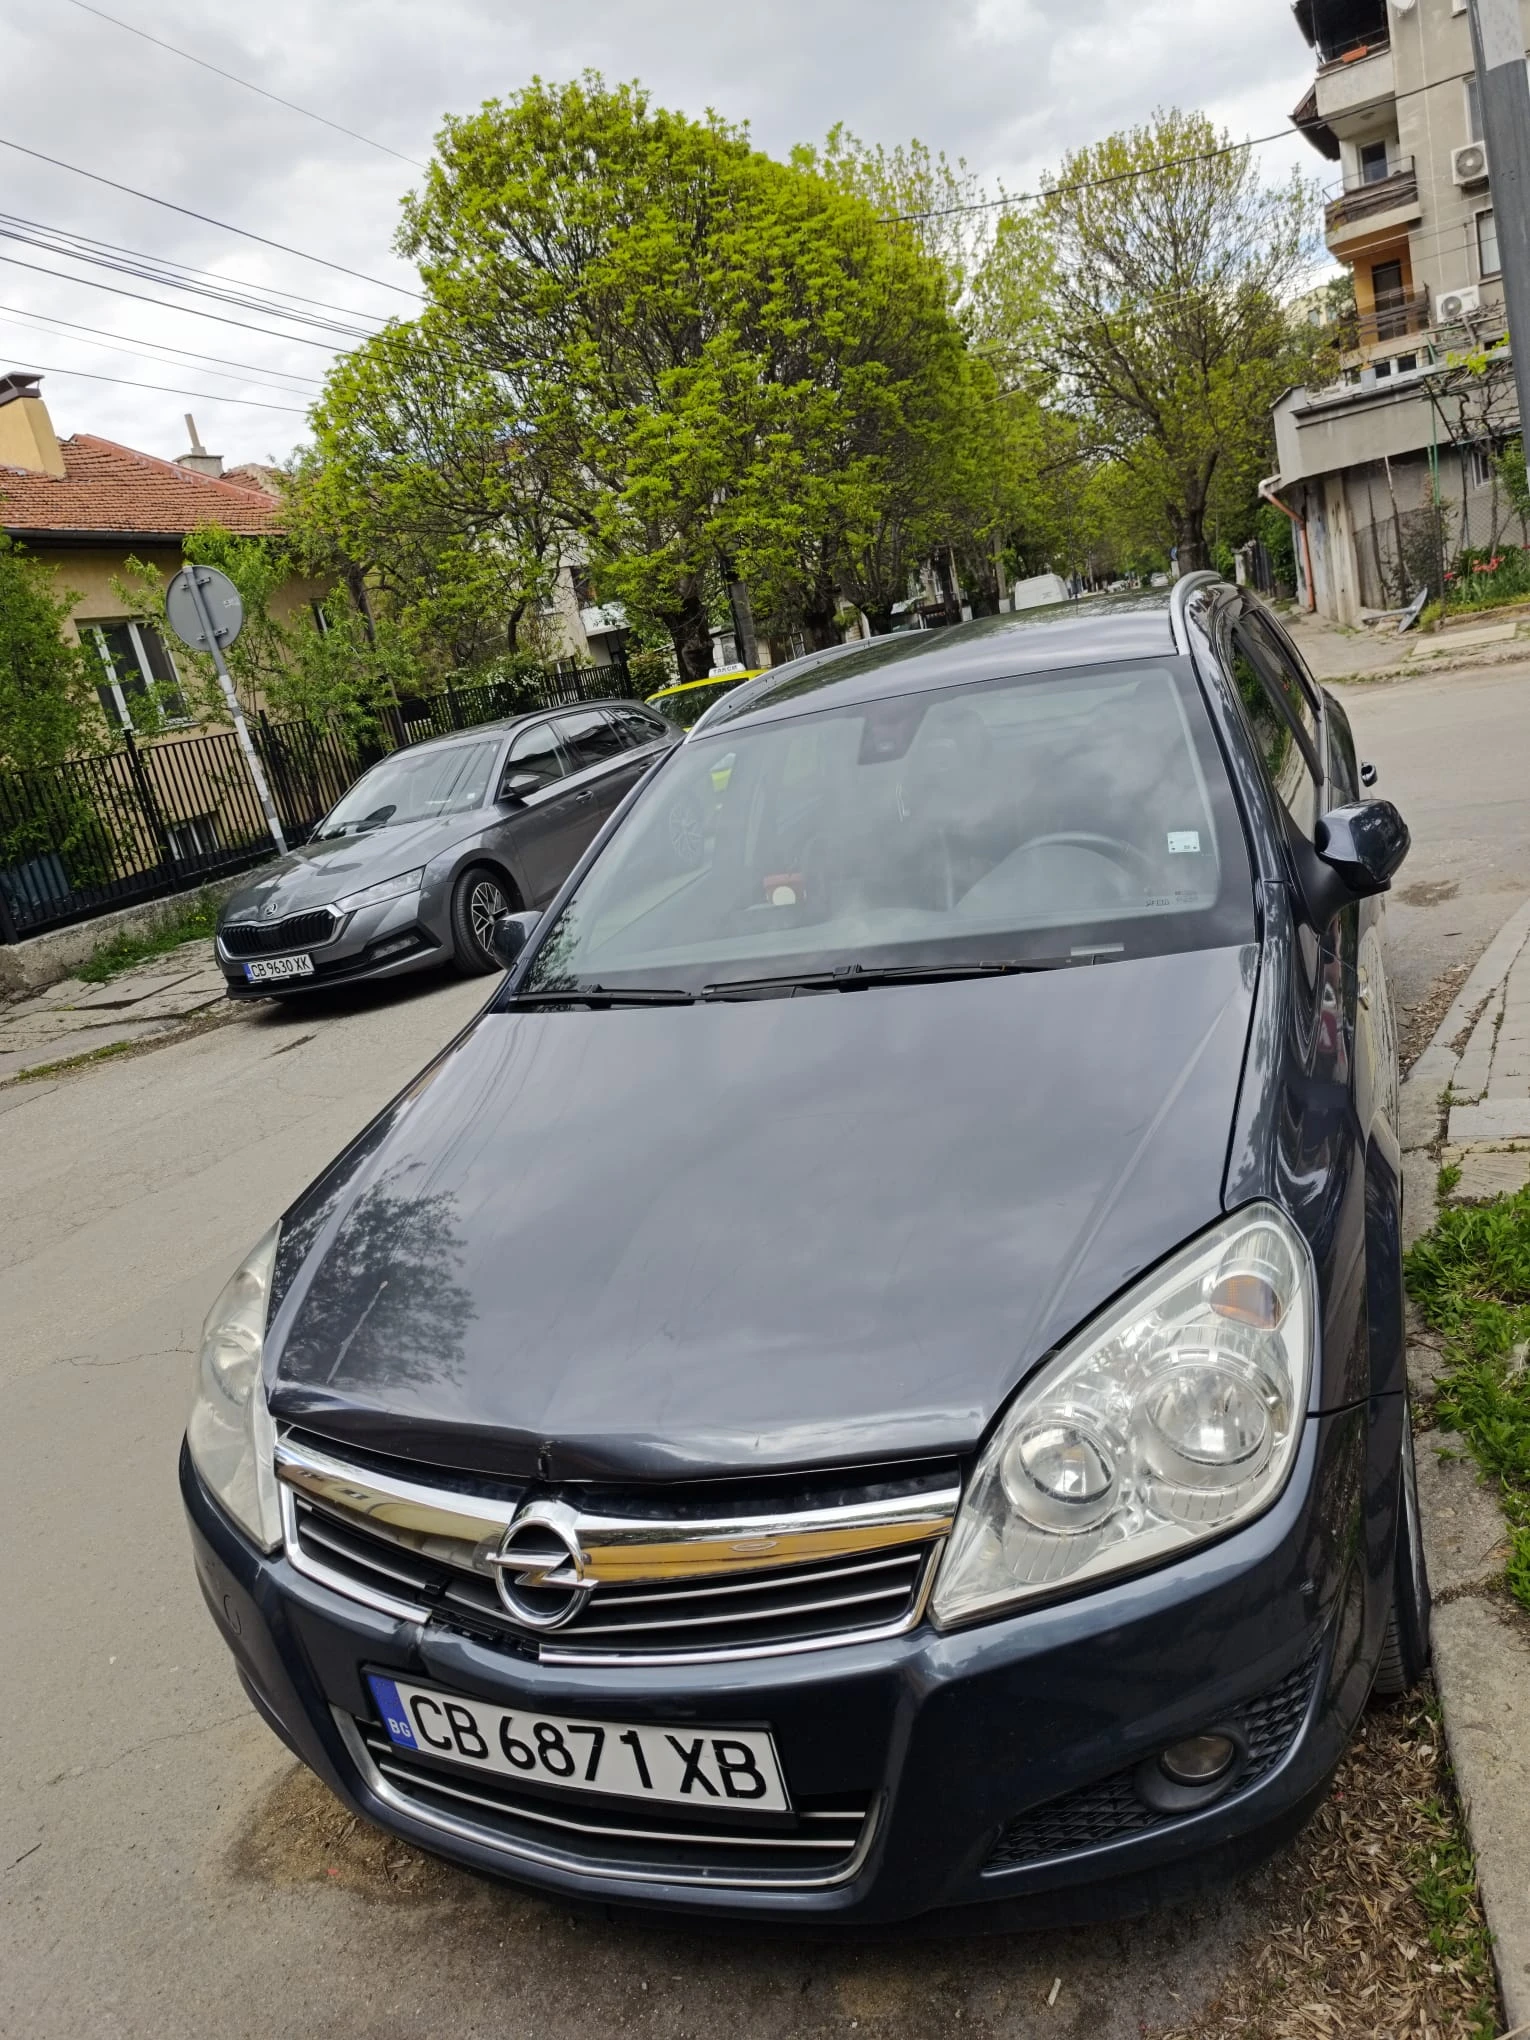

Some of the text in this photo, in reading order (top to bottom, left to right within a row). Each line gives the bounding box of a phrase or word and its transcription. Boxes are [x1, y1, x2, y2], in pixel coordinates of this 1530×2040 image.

[267, 960, 293, 975] 9630
[387, 1717, 411, 1738] BG
[409, 1694, 768, 1799] CB 6871 XB
